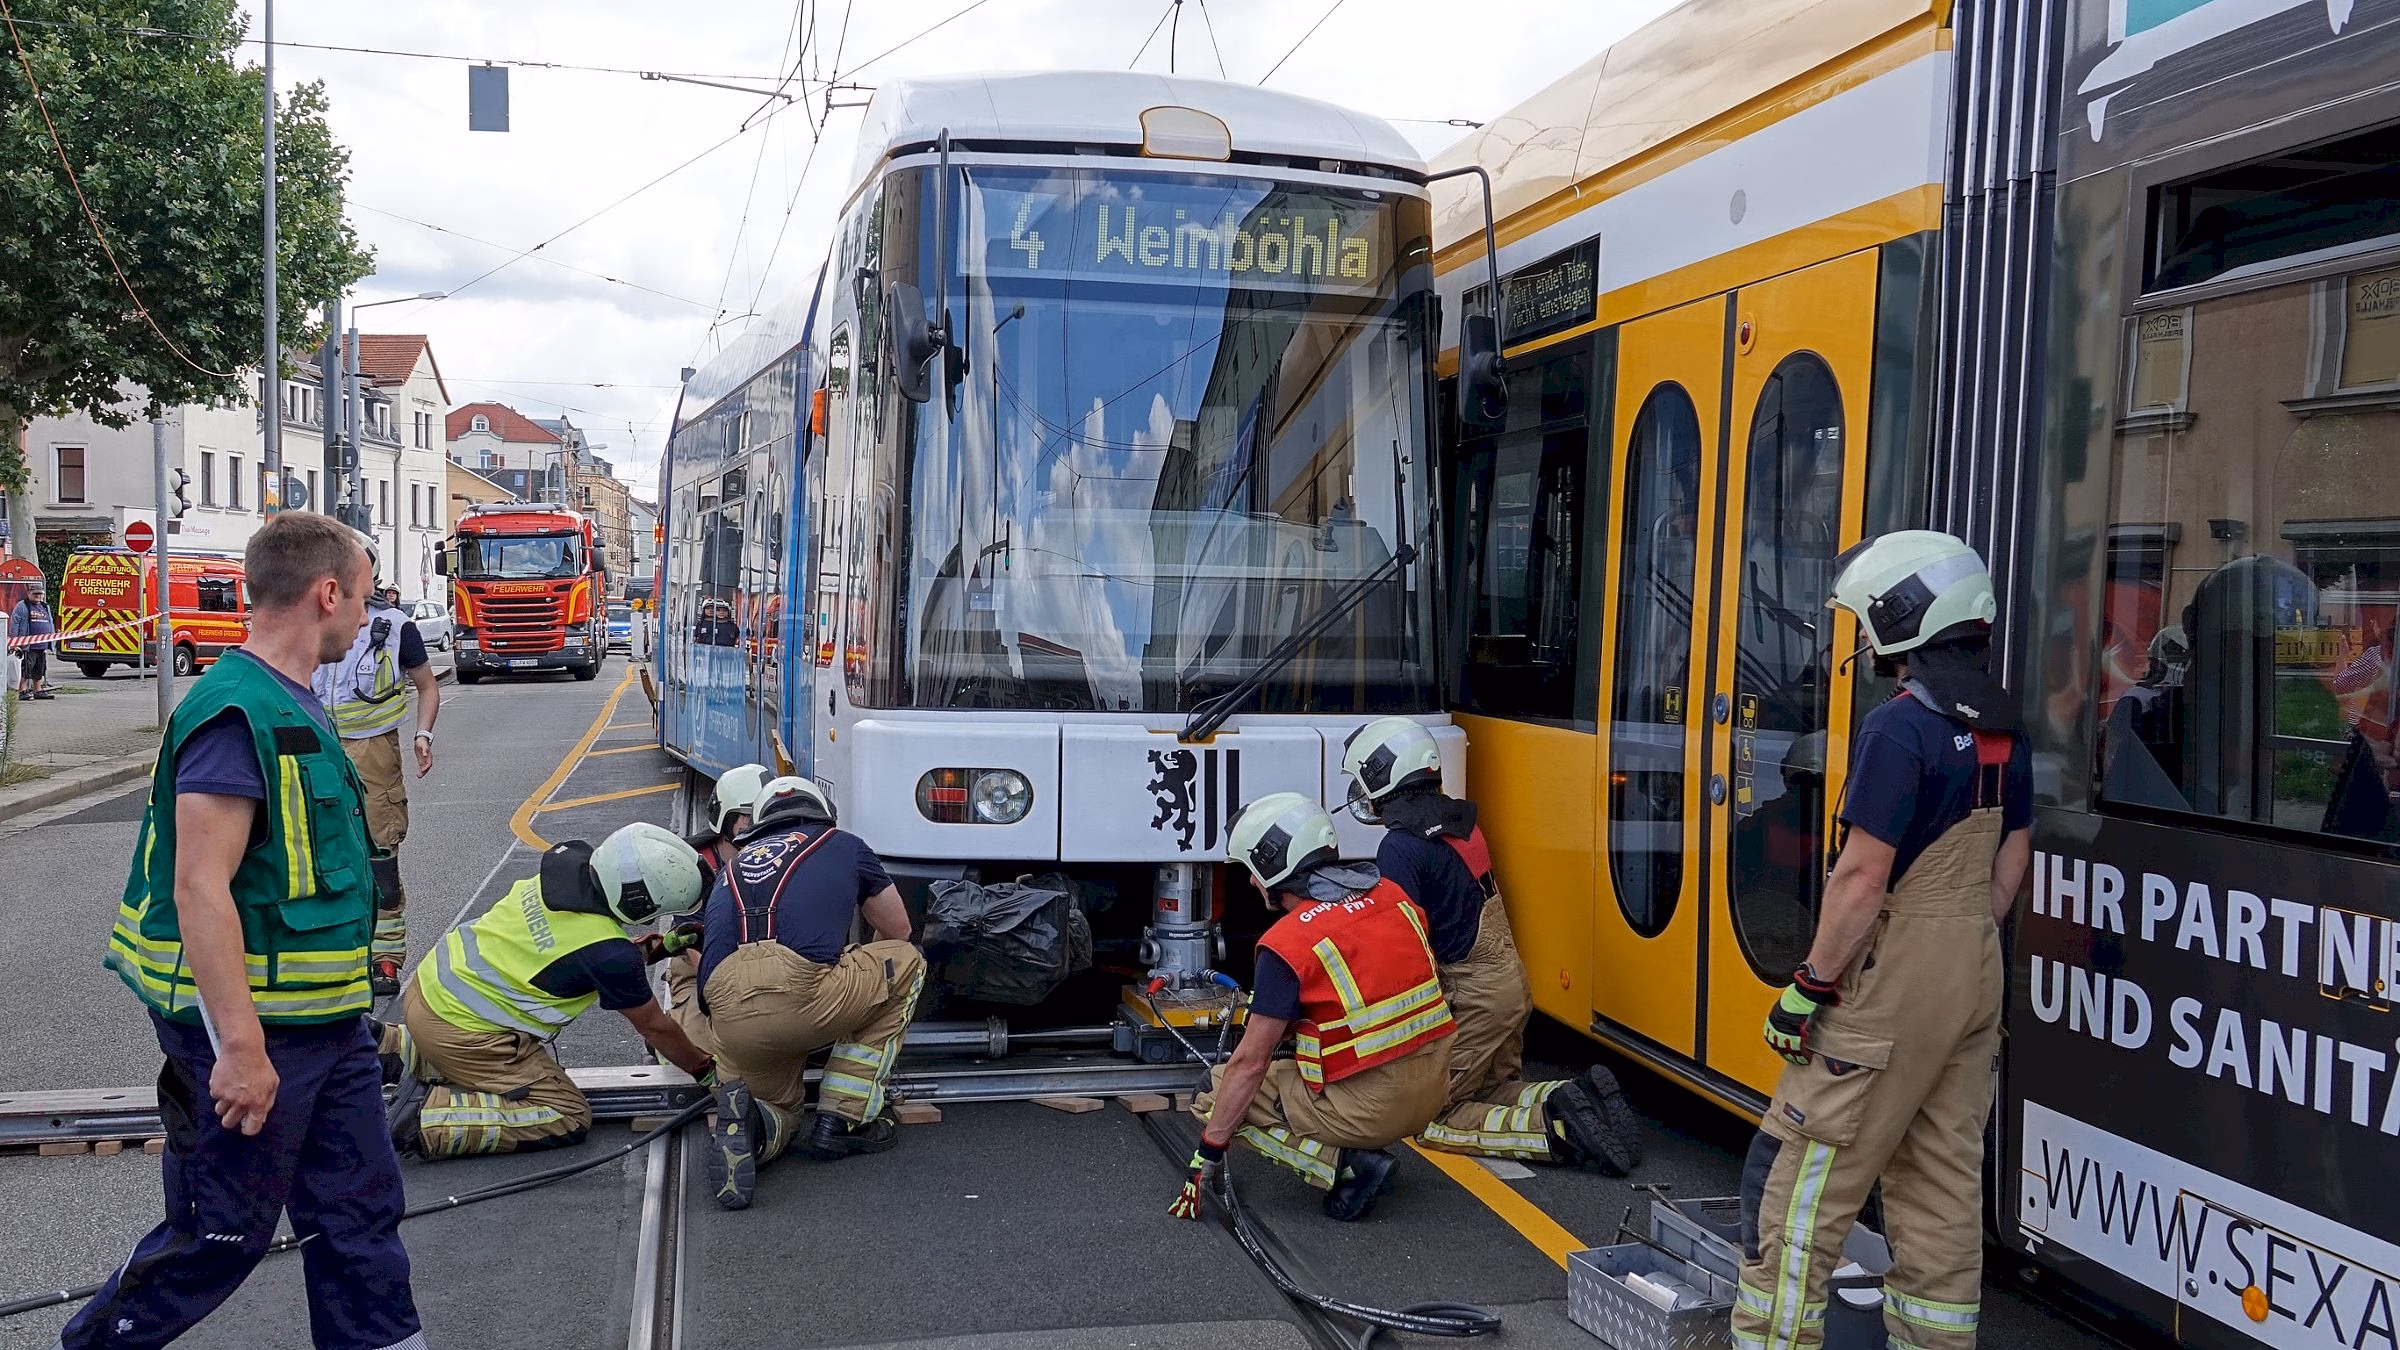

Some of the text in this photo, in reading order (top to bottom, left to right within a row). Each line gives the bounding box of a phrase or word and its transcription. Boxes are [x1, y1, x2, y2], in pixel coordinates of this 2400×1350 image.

[1010, 192, 1369, 278] 4 Weinböhla
[1536, 265, 1564, 294] endet
[1566, 261, 1592, 283] hier,
[1513, 287, 1591, 328] nicht einsteigen
[73, 578, 130, 588] FEUERWEHR
[81, 586, 123, 595] DRESDEN
[493, 584, 545, 593] FEUERWEHR
[2031, 851, 2125, 935] IHR
[2030, 955, 2153, 1050] UND
[2042, 1138, 2400, 1350] WWW.SEXA
